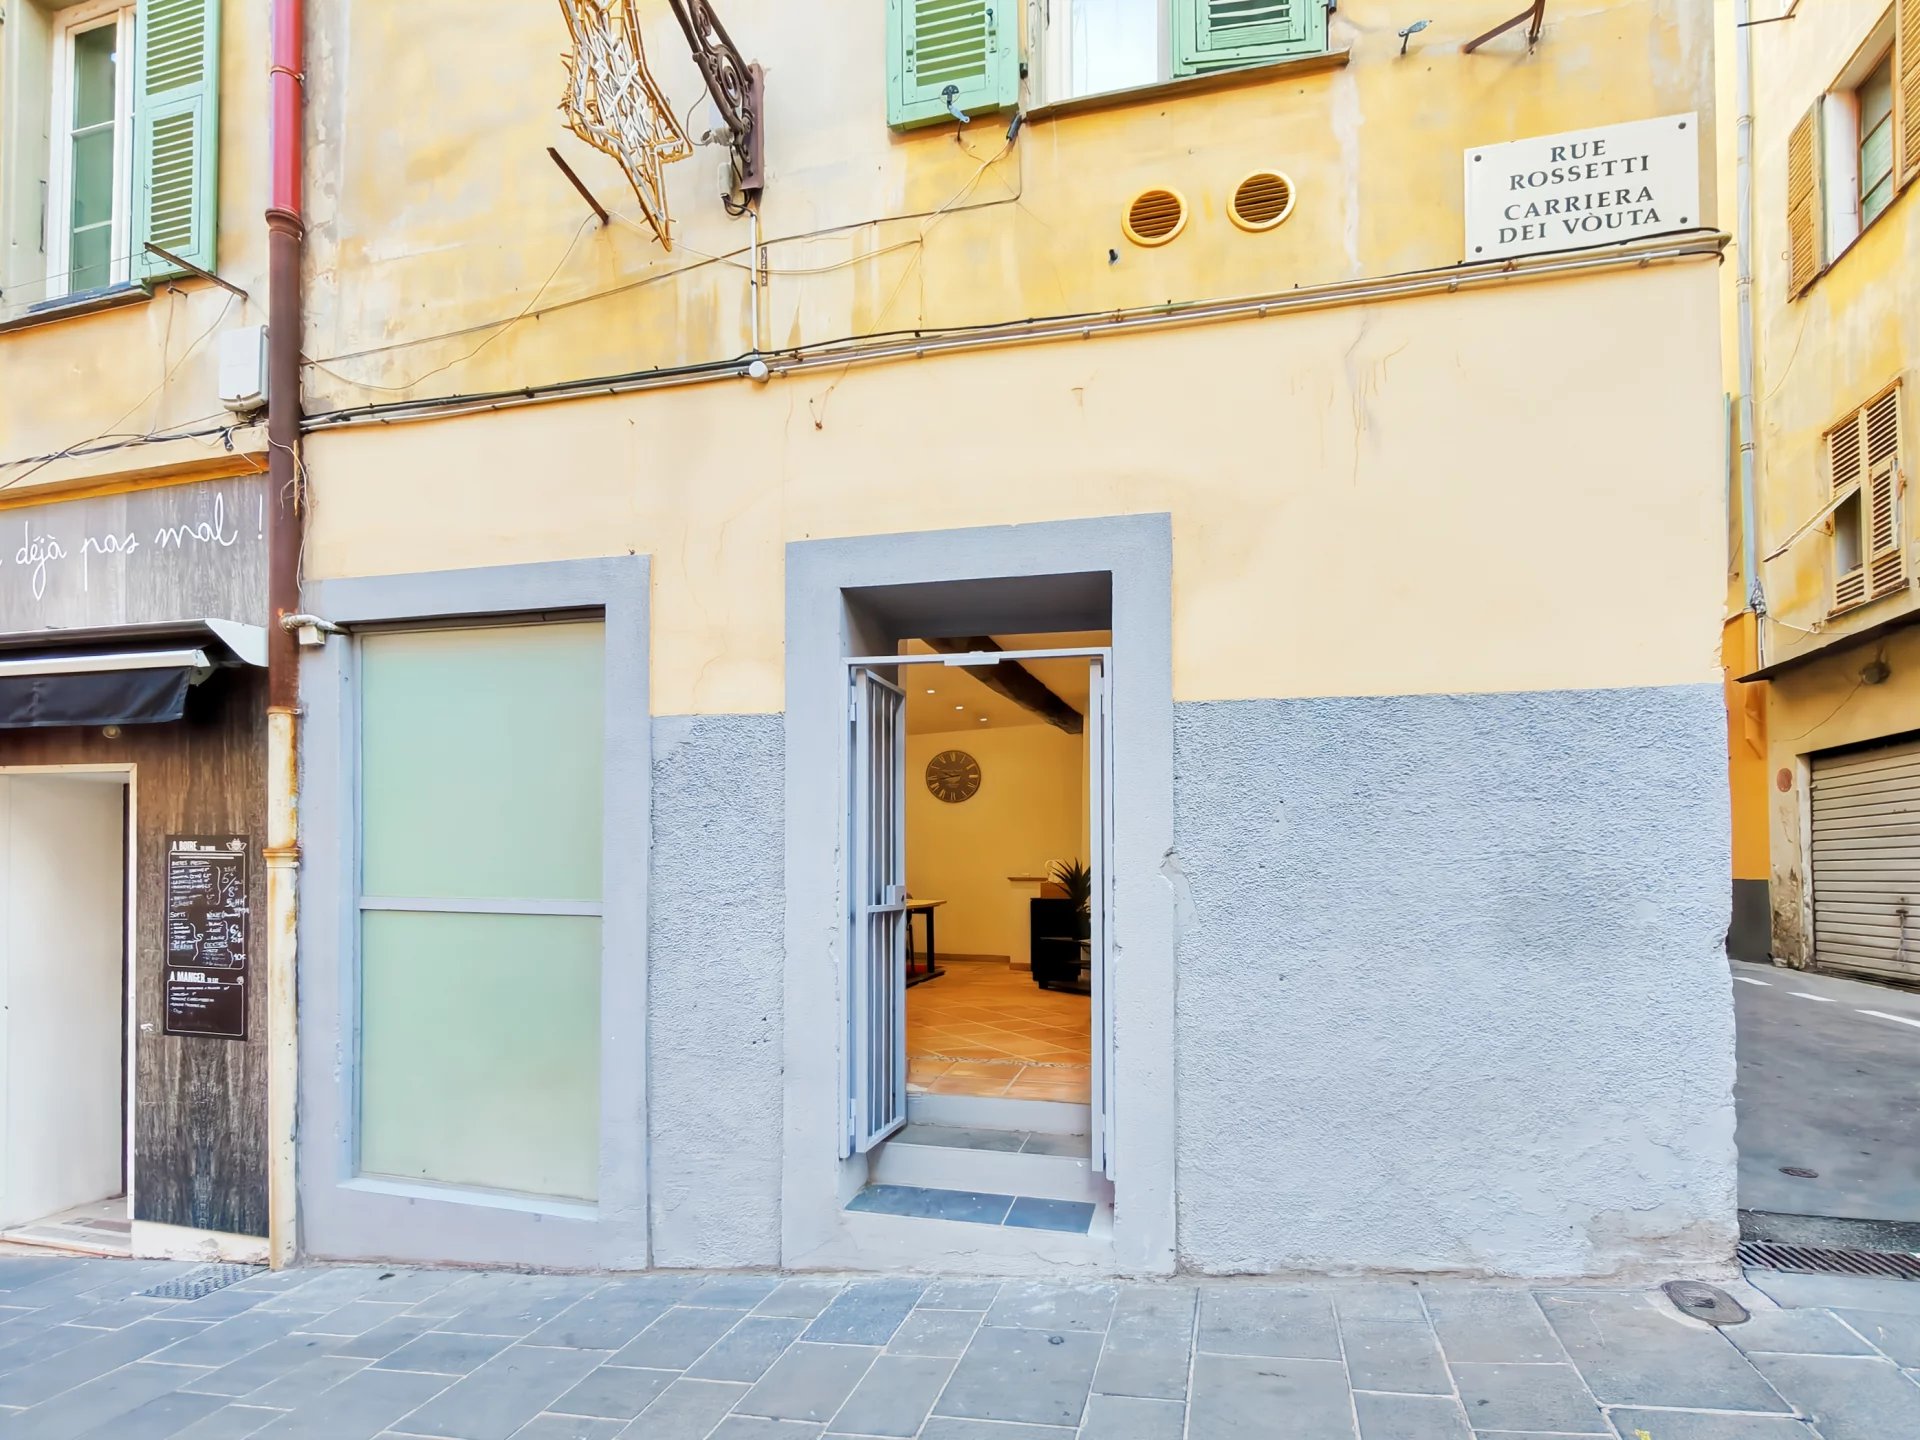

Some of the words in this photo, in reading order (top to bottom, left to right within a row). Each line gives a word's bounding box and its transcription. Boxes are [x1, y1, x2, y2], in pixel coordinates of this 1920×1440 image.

[1550, 139, 1606, 163] RUE
[1509, 154, 1650, 191] ROSSETTI
[1504, 185, 1655, 221] CARRIERA
[1499, 222, 1547, 244] DEI
[1562, 207, 1661, 235] VÒUTA
[15, 520, 68, 601] déjà
[80, 531, 140, 592] pas
[155, 491, 238, 549] mal
[177, 971, 205, 983] MANGER
